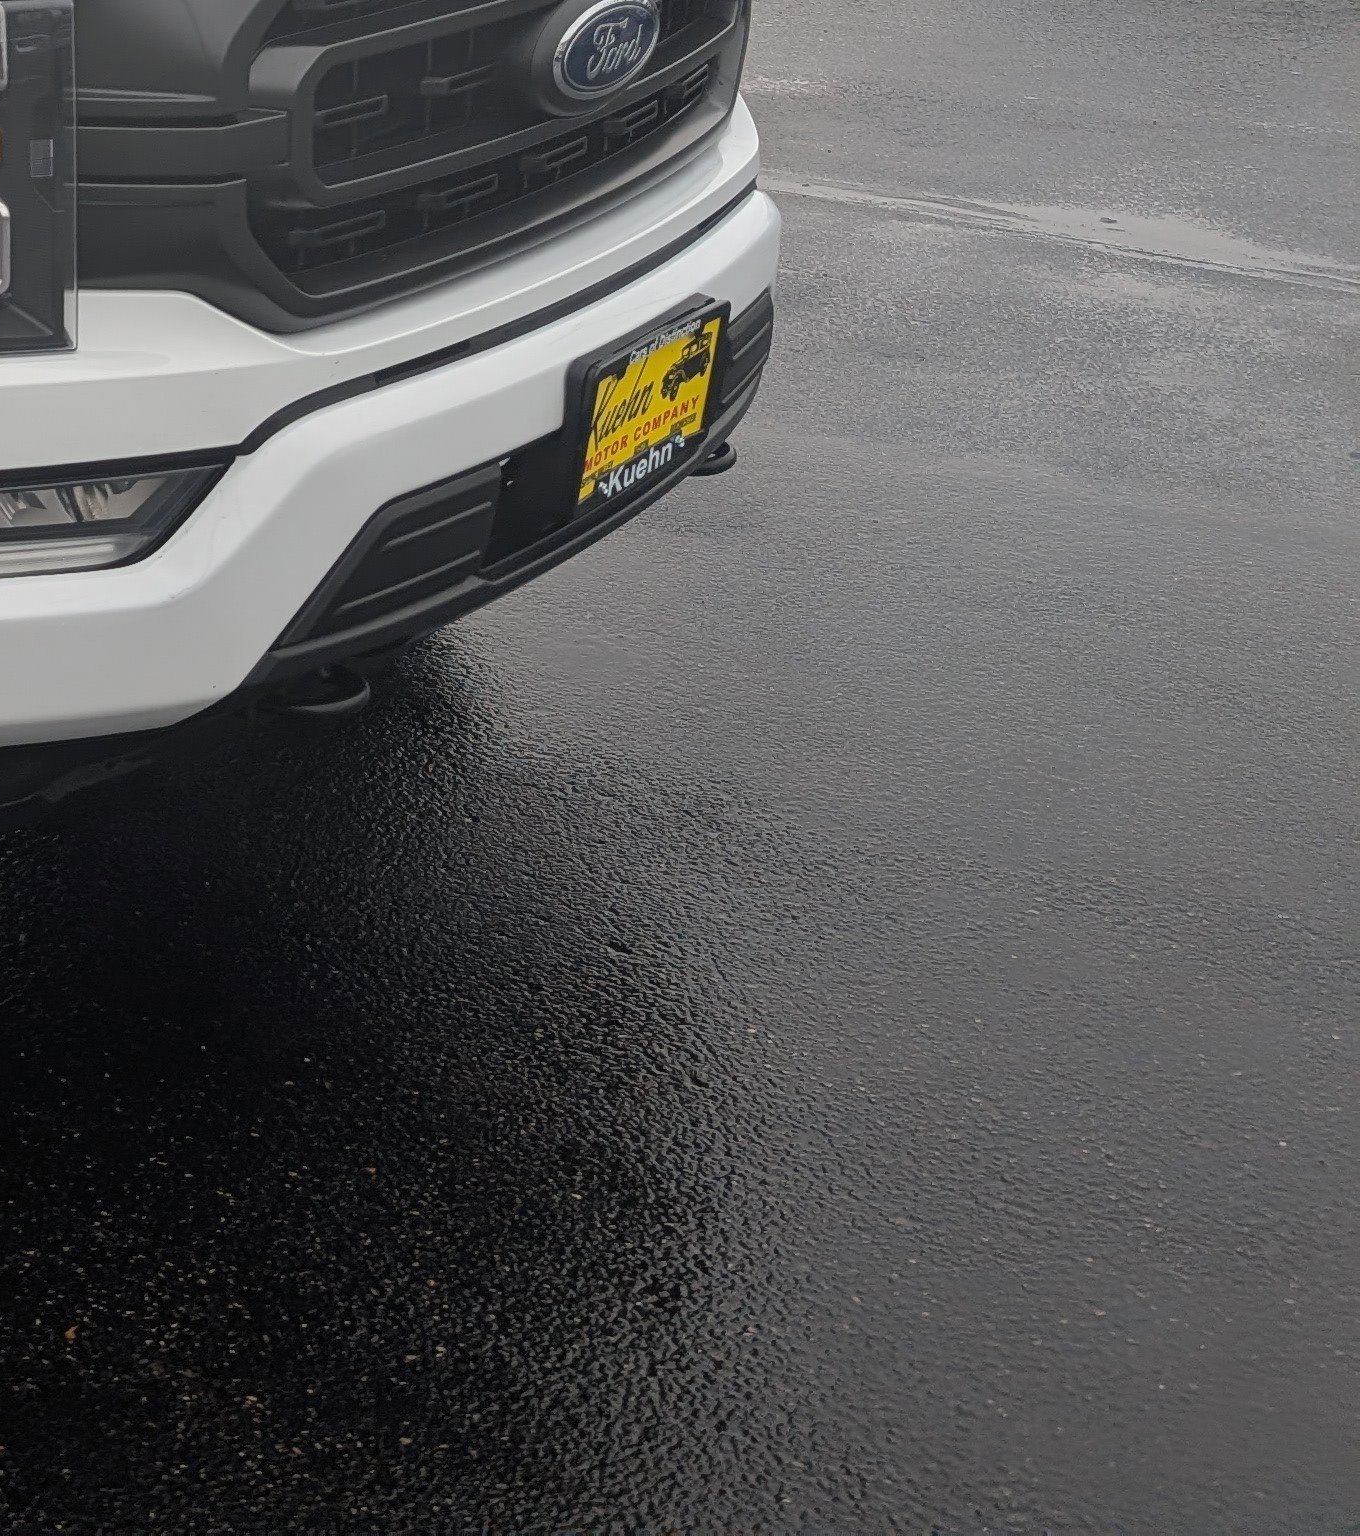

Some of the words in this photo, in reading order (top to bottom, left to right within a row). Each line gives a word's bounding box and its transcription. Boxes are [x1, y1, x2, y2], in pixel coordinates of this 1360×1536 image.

[586, 17, 644, 80] Ford
[584, 434, 629, 472] MOTOR
[633, 395, 700, 442] COMPANY
[592, 357, 654, 451] Kuehn
[607, 442, 673, 498] Kuehn
